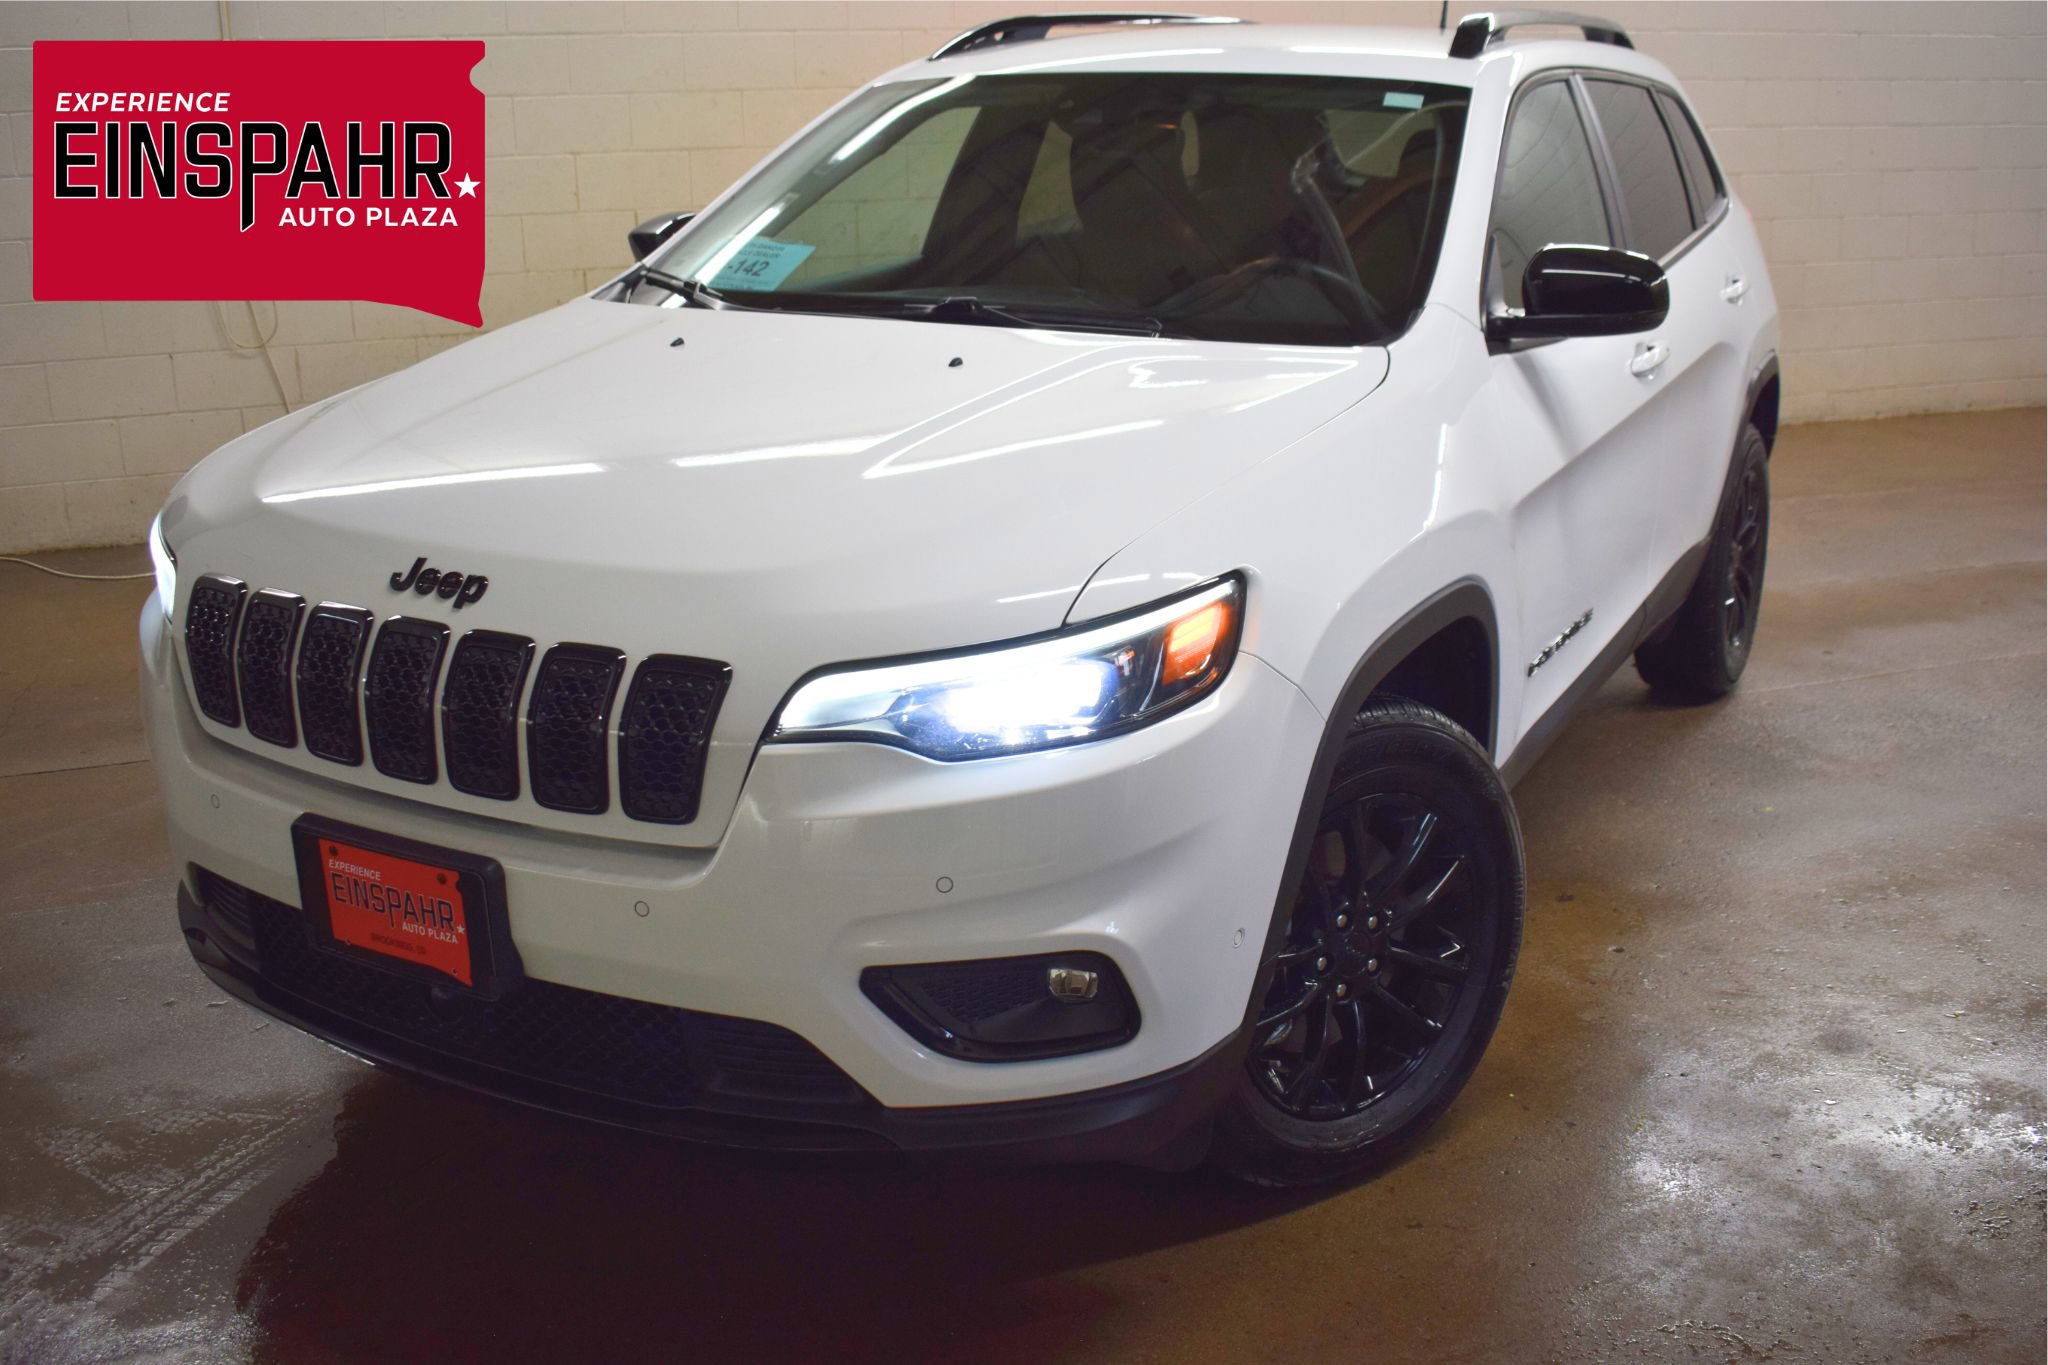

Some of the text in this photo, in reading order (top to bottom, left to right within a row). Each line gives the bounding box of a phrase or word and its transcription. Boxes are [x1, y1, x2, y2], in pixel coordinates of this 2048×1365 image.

[390, 557, 489, 609] Jeep
[328, 859, 381, 881] EXPERIENCE
[330, 871, 455, 932] EINSPAHR
[402, 922, 426, 936] AUTO
[428, 928, 458, 944] PLAZA
